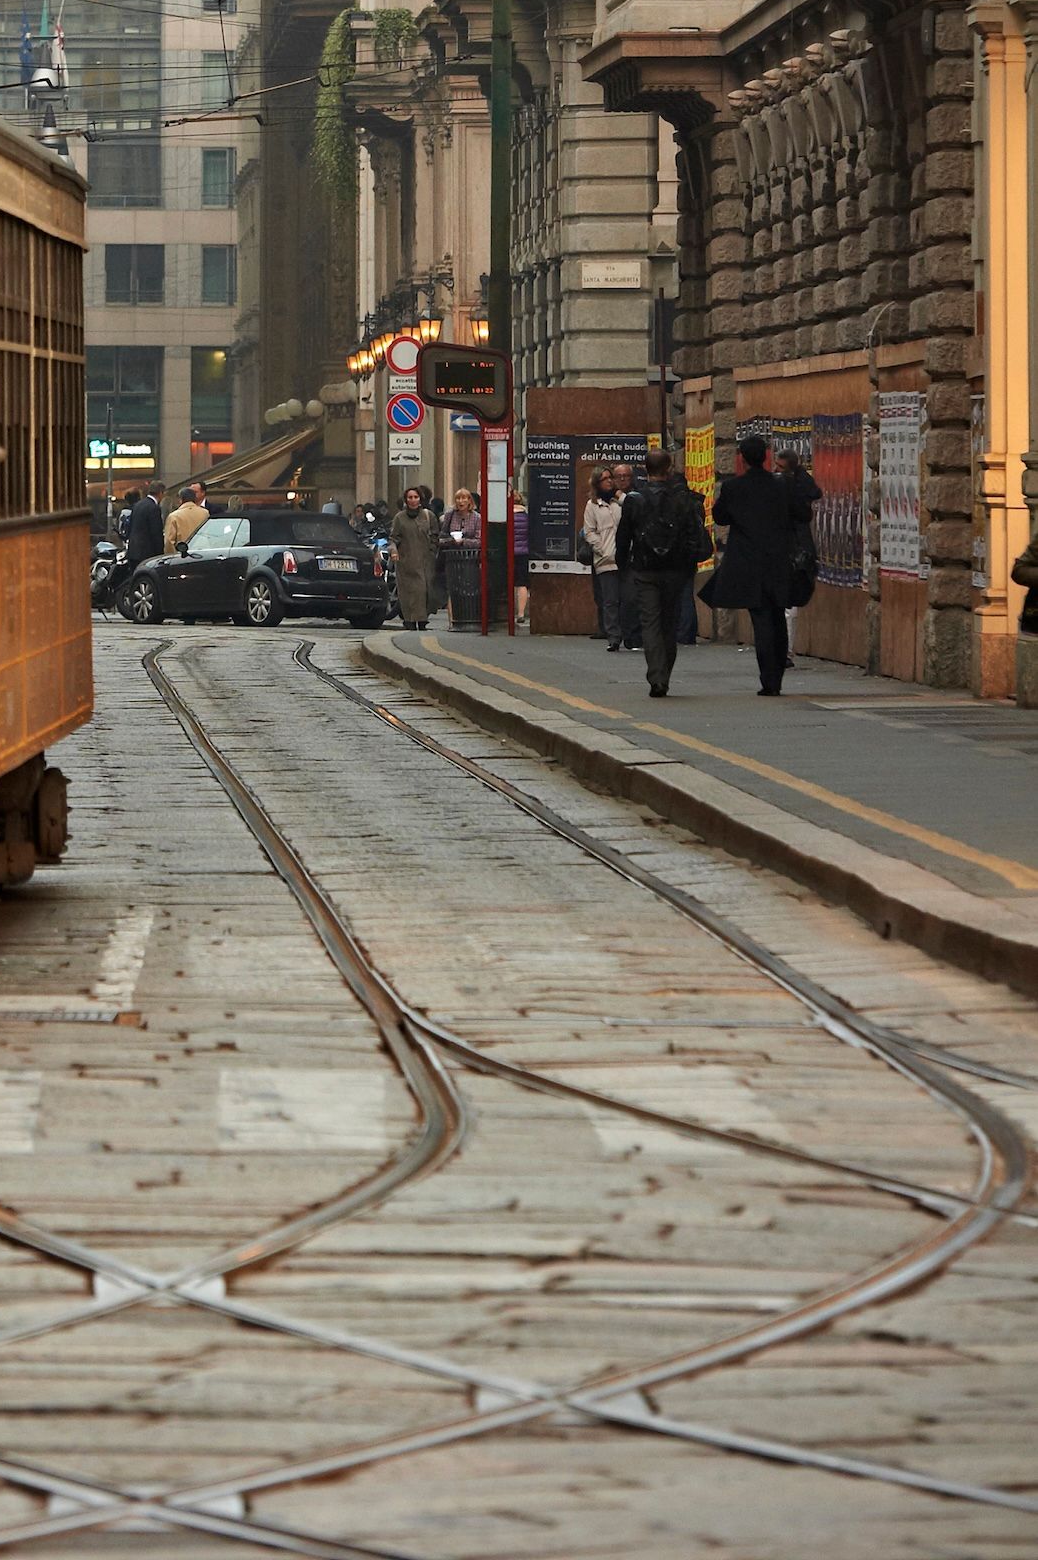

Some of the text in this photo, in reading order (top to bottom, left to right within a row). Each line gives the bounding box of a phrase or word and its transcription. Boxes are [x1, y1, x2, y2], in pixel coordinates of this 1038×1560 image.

[528, 441, 570, 450] buddhista
[527, 451, 570, 460] orientale
[581, 453, 621, 461] dell'Asia
